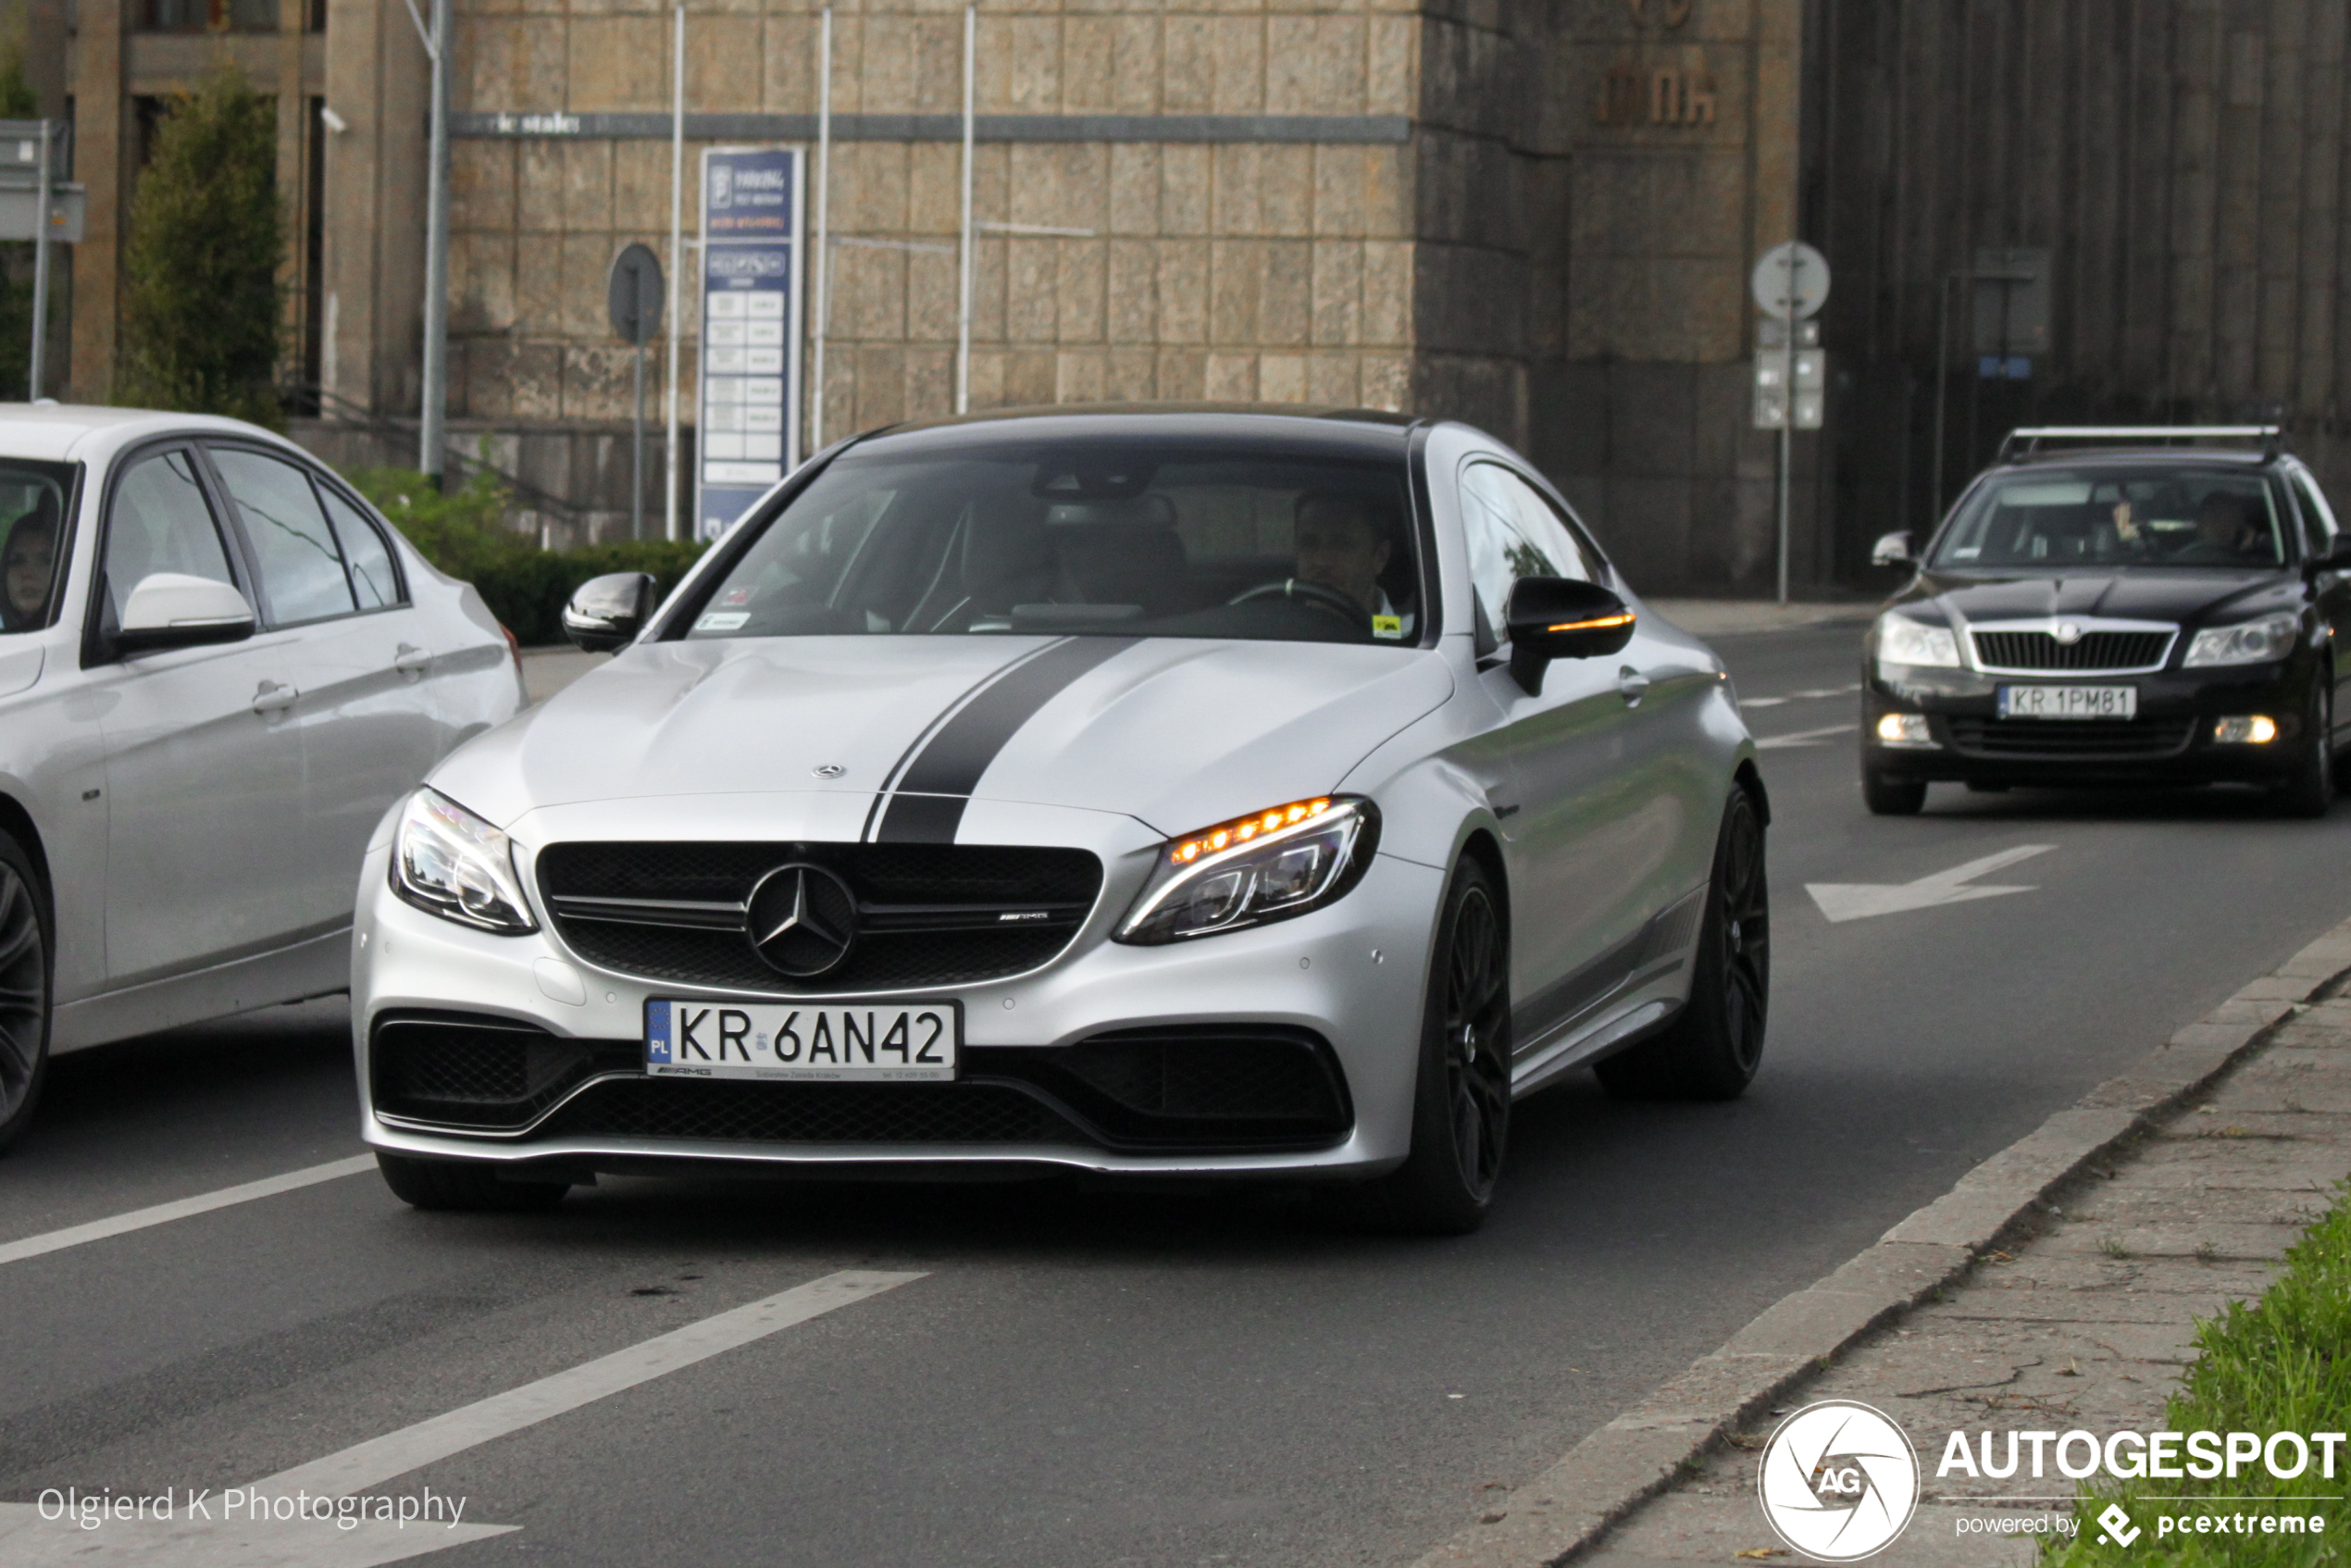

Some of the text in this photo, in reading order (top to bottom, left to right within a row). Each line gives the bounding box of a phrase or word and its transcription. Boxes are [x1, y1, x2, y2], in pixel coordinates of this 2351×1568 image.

[2015, 690, 2128, 714] KR 1PM81
[651, 1040, 668, 1054] PL
[680, 1008, 944, 1064] KR 6AN42
